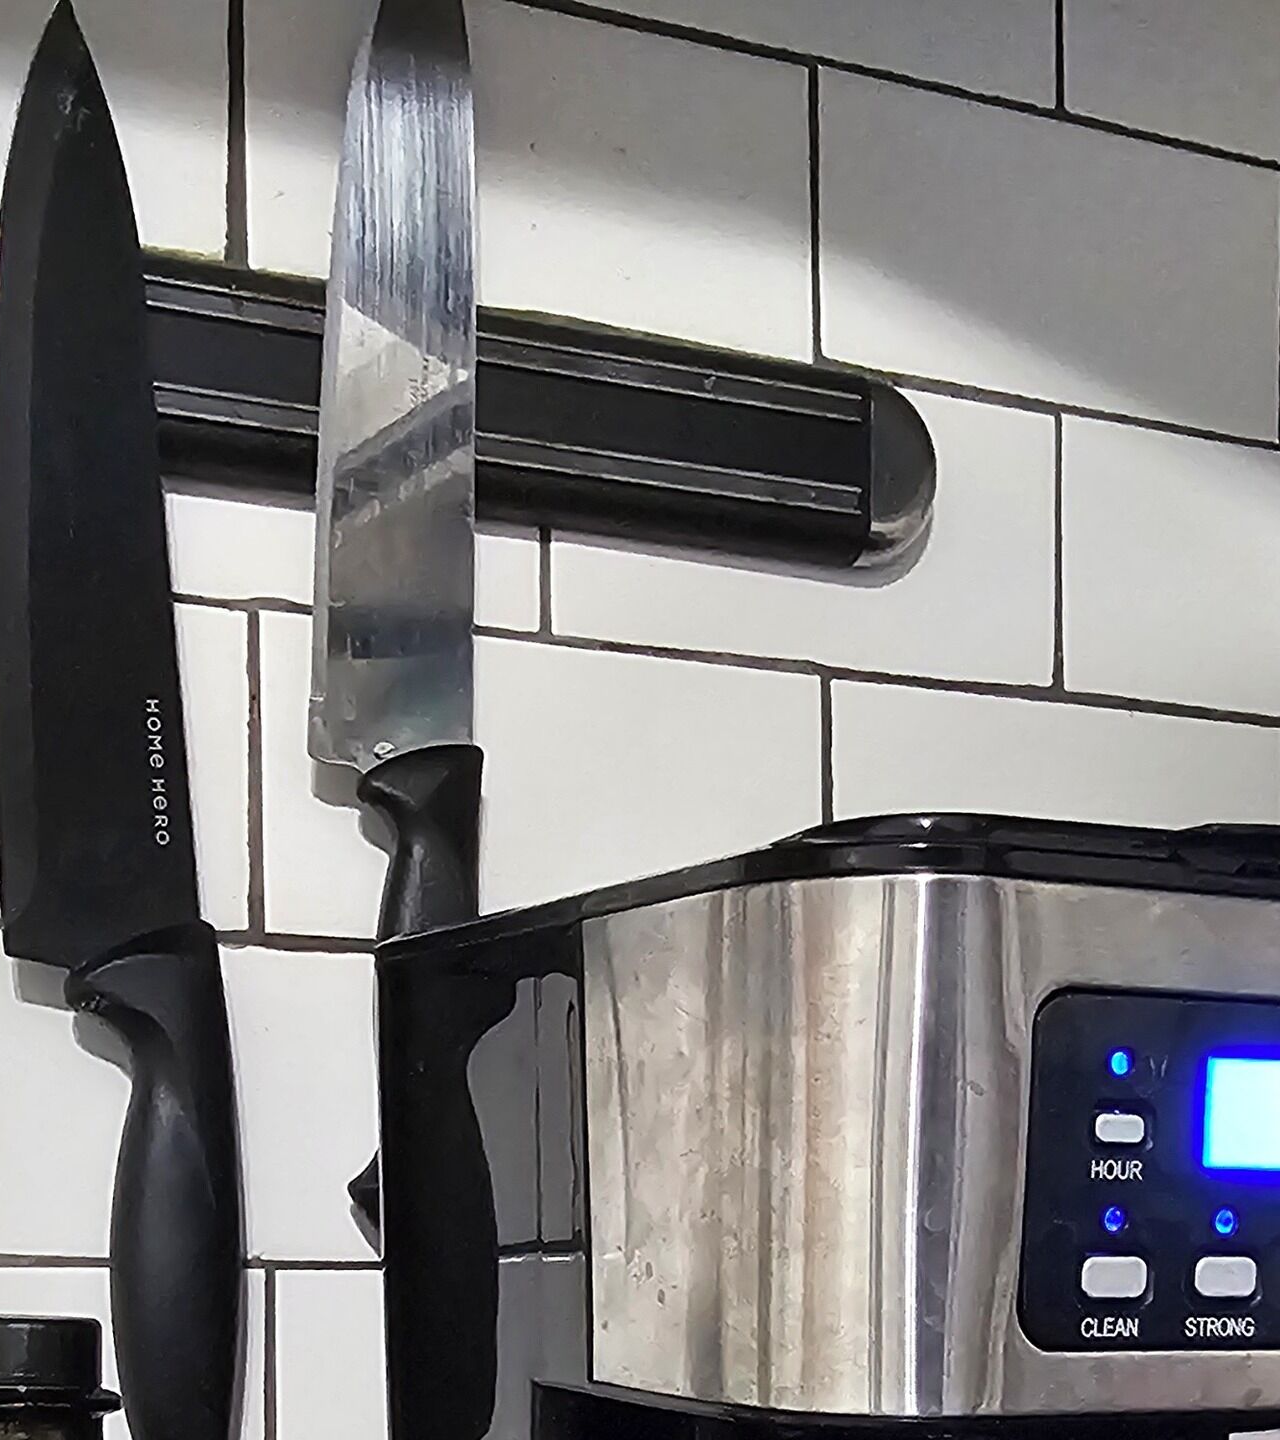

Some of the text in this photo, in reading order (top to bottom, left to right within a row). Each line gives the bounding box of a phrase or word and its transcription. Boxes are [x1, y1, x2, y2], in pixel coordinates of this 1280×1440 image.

[1090, 1159, 1143, 1180] HOUR
[1080, 1317, 1139, 1337] CLEAN
[1184, 1317, 1256, 1337] STRONG
